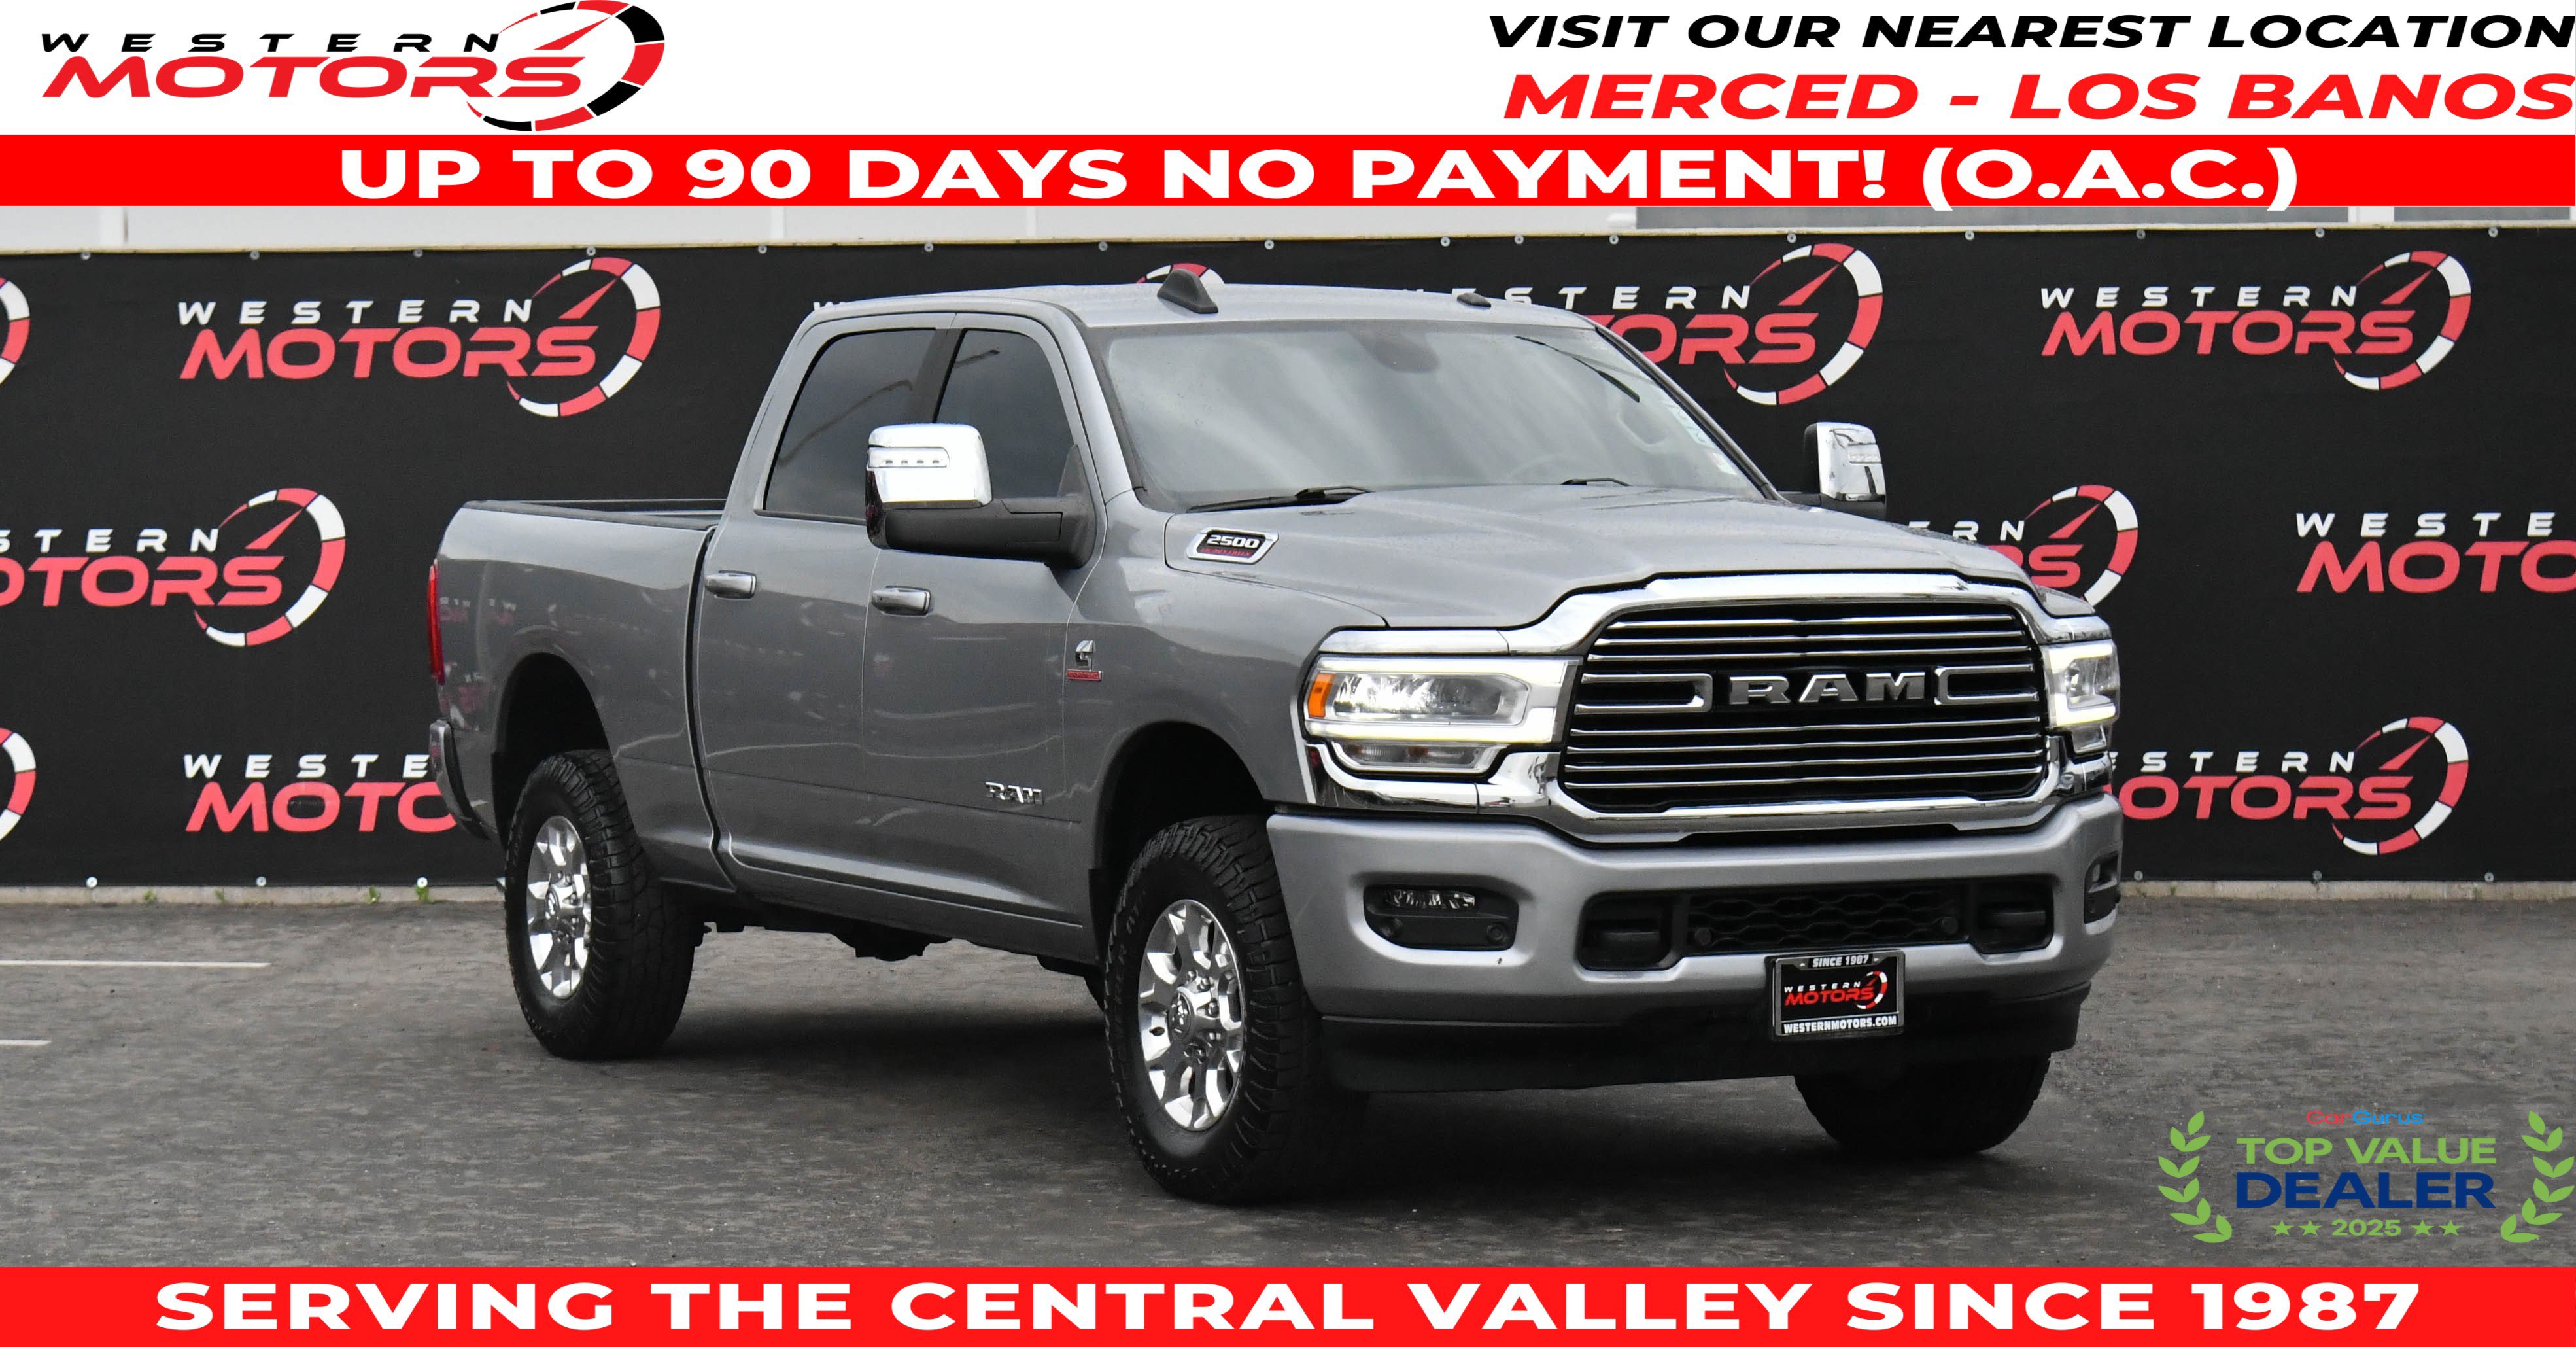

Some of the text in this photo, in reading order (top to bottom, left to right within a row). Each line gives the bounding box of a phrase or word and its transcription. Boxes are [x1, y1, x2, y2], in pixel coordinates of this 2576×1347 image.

[2040, 286, 2357, 309] WESTERN
[178, 299, 532, 326] WESTERN
[1587, 313, 1819, 365] ORS
[2042, 309, 2416, 357] MOTORS
[180, 325, 599, 380] MOTORS
[1207, 534, 1260, 549] 2500
[1728, 672, 1925, 705] RAM
[984, 781, 1045, 805] RAM
[2103, 775, 2414, 821] OTORS
[1812, 954, 1869, 968] SINCE 1987
[1783, 981, 1861, 993] WESTERN
[1784, 987, 1875, 1006] MOTORS
[1783, 1015, 1897, 1034] WESTERNMOTORS.COM
